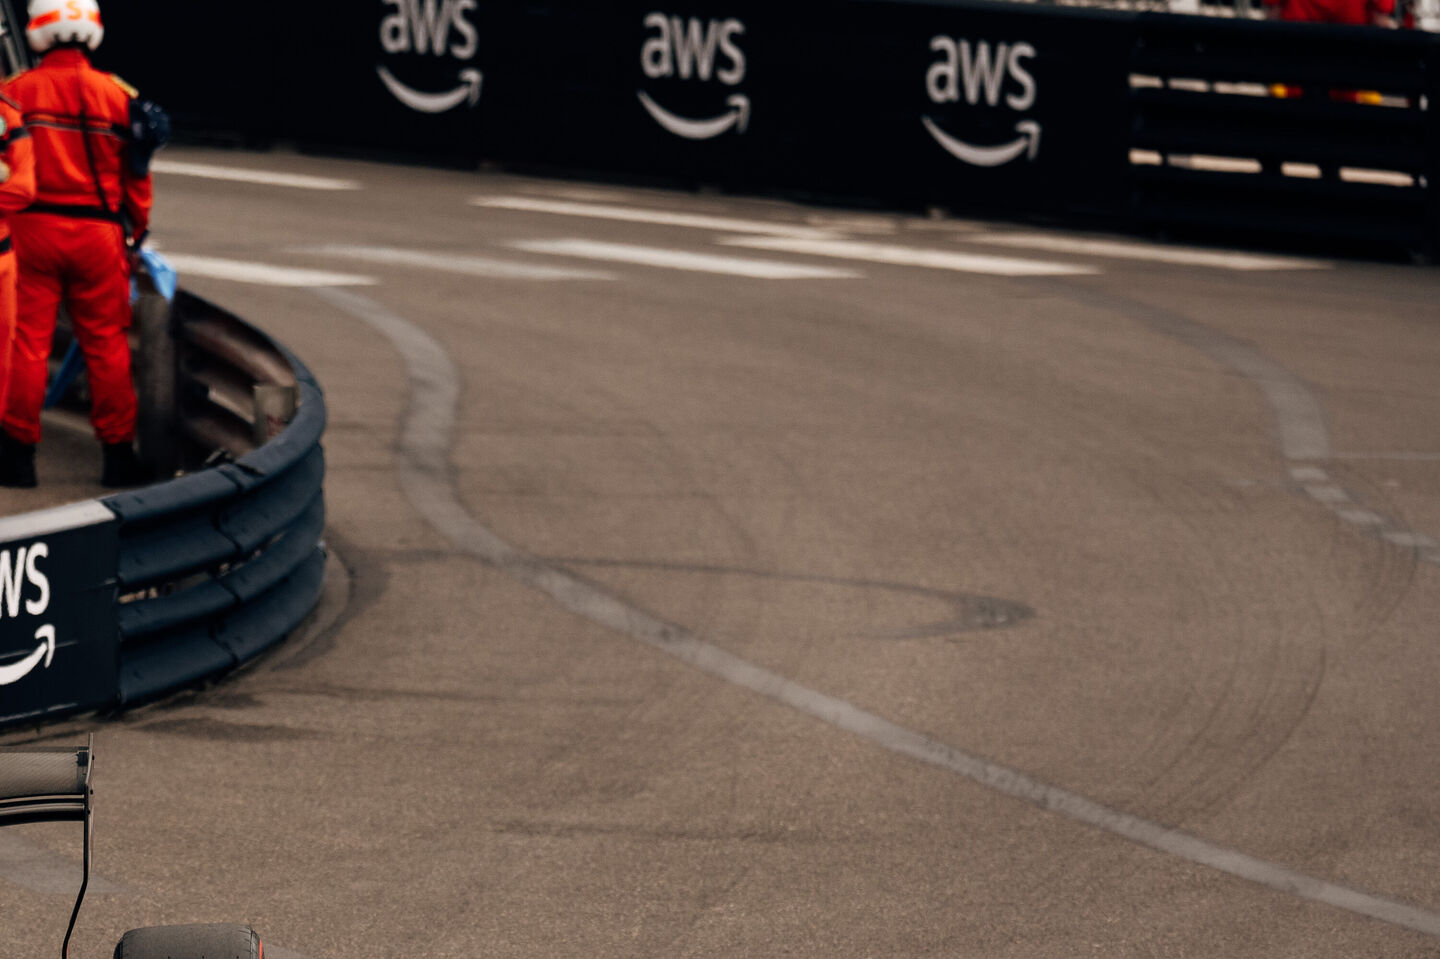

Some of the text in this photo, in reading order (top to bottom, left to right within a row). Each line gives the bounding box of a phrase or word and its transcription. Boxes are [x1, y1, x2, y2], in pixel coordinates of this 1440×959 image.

[380, 0, 477, 59] aws
[641, 13, 745, 85] aws
[926, 35, 1036, 111] aws
